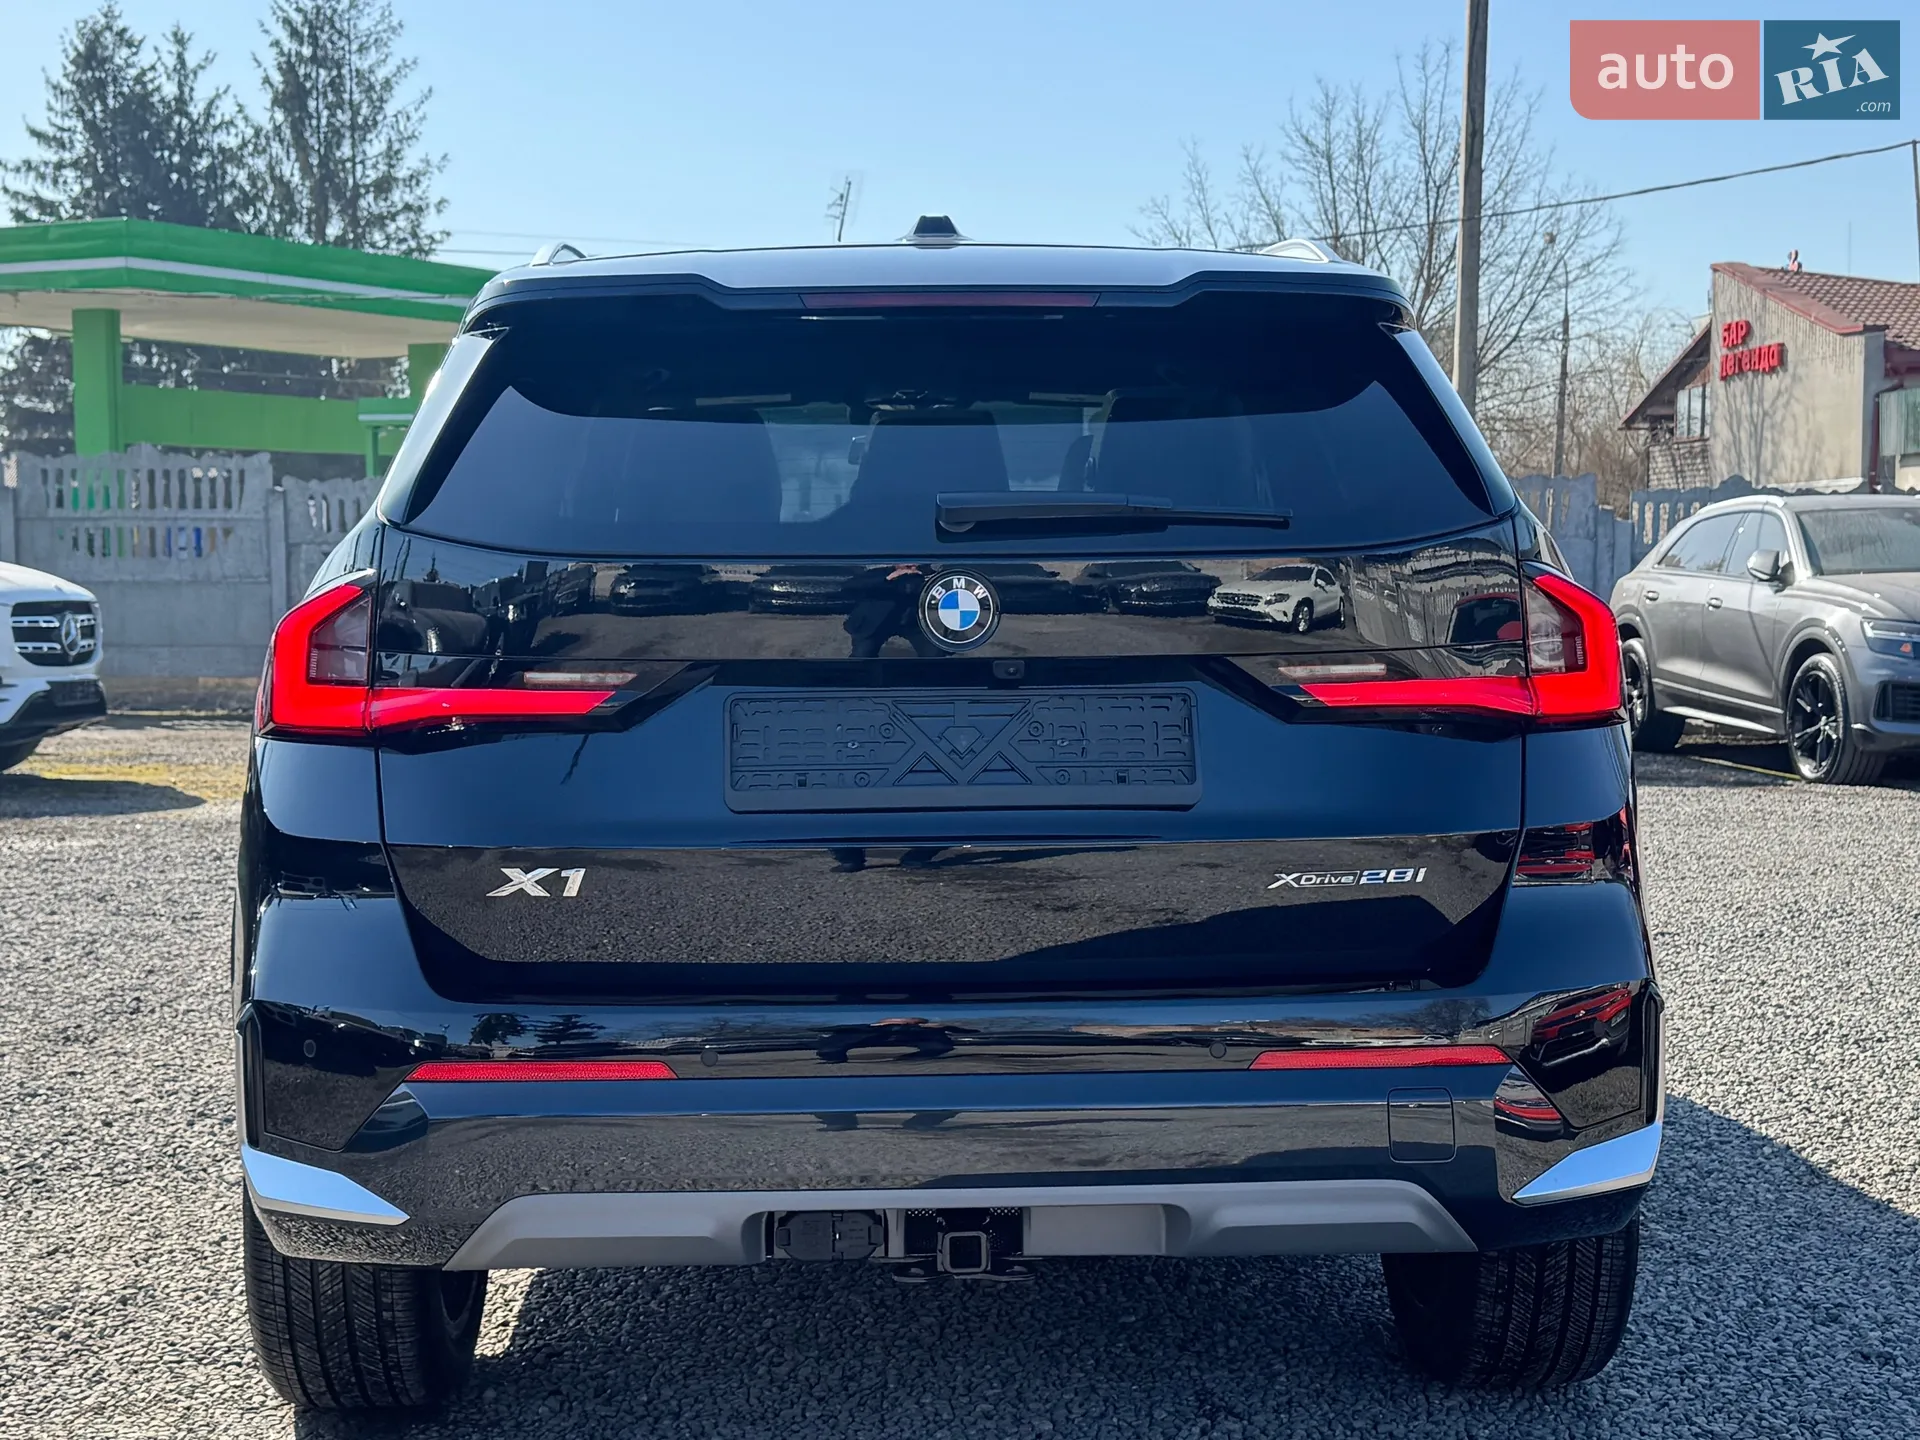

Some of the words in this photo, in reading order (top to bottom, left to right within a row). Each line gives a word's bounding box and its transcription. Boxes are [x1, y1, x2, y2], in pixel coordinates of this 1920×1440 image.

[1721, 320, 1749, 348] БАР
[931, 578, 988, 600] BMW
[486, 867, 586, 897] X1
